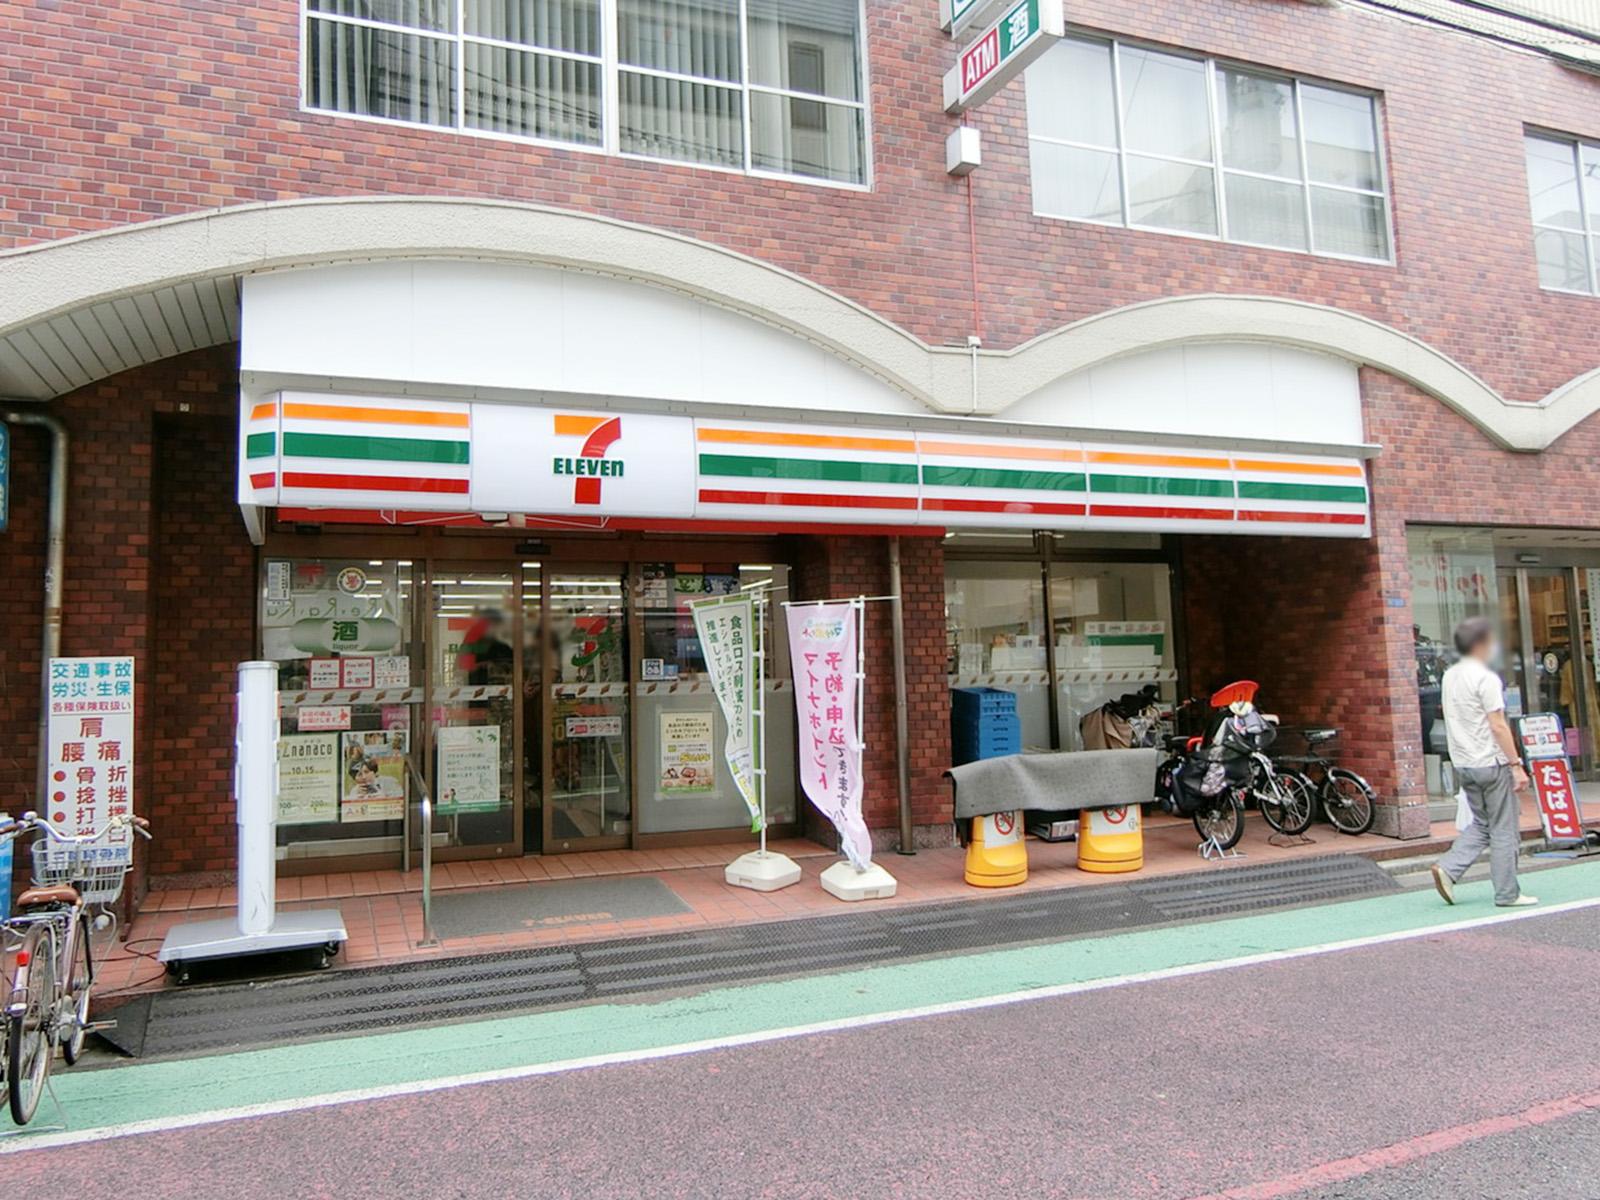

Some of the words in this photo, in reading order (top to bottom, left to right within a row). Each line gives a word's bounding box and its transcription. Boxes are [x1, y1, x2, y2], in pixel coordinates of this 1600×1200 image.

[1008, 3, 1029, 51] 酒
[966, 34, 995, 87] ATM
[332, 621, 358, 641] 酒
[332, 643, 358, 651] liquor
[52, 662, 131, 679] 交通事故
[52, 680, 131, 698] 労災・生保
[52, 701, 131, 712] 各種保険取扱い
[80, 717, 103, 738] 肩
[292, 744, 333, 756] nanaco
[1541, 765, 1573, 834] たばこ
